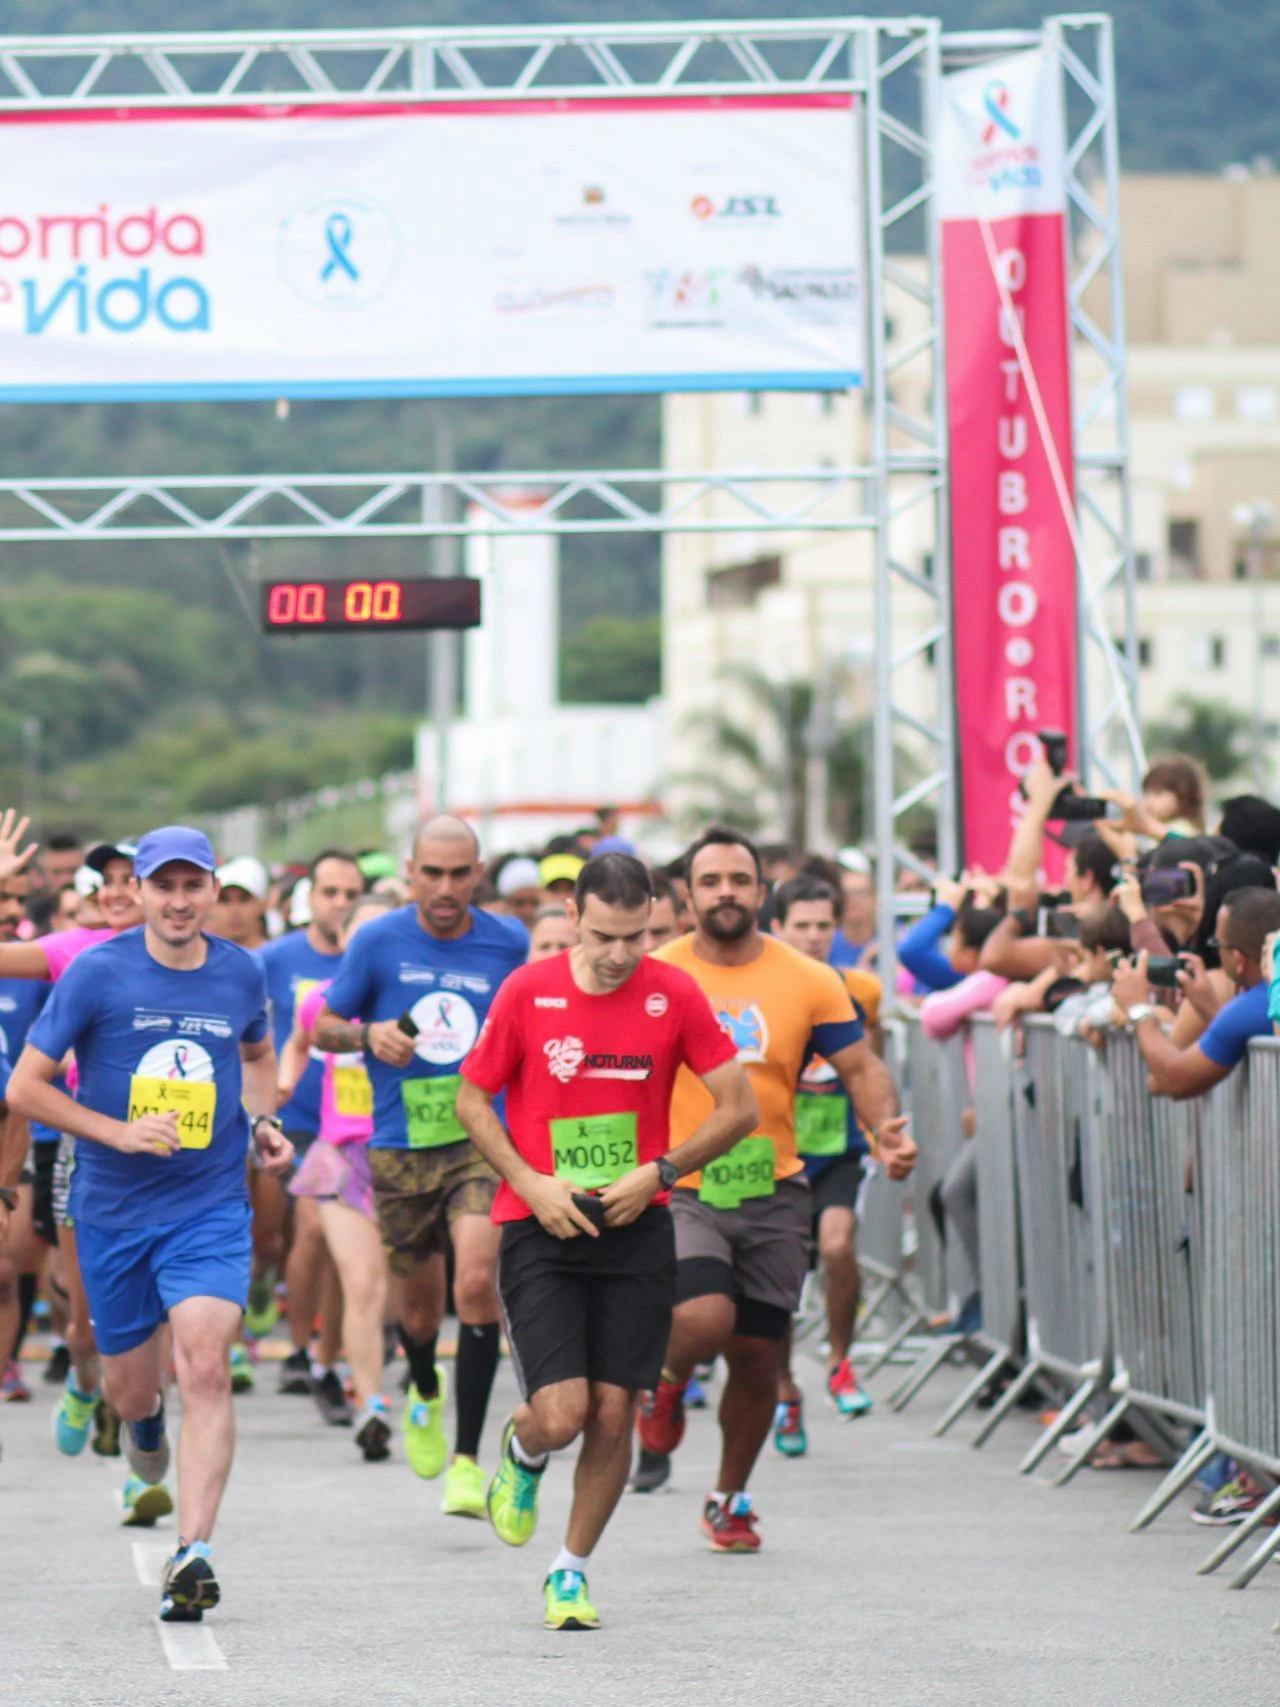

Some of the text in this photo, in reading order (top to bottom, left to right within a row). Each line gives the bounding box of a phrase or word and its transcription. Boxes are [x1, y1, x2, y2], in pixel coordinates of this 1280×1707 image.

[20, 265, 214, 336] vida
[583, 1054, 654, 1069] NOTURNA
[130, 1103, 210, 1133] M44
[554, 1140, 635, 1171] M0052
